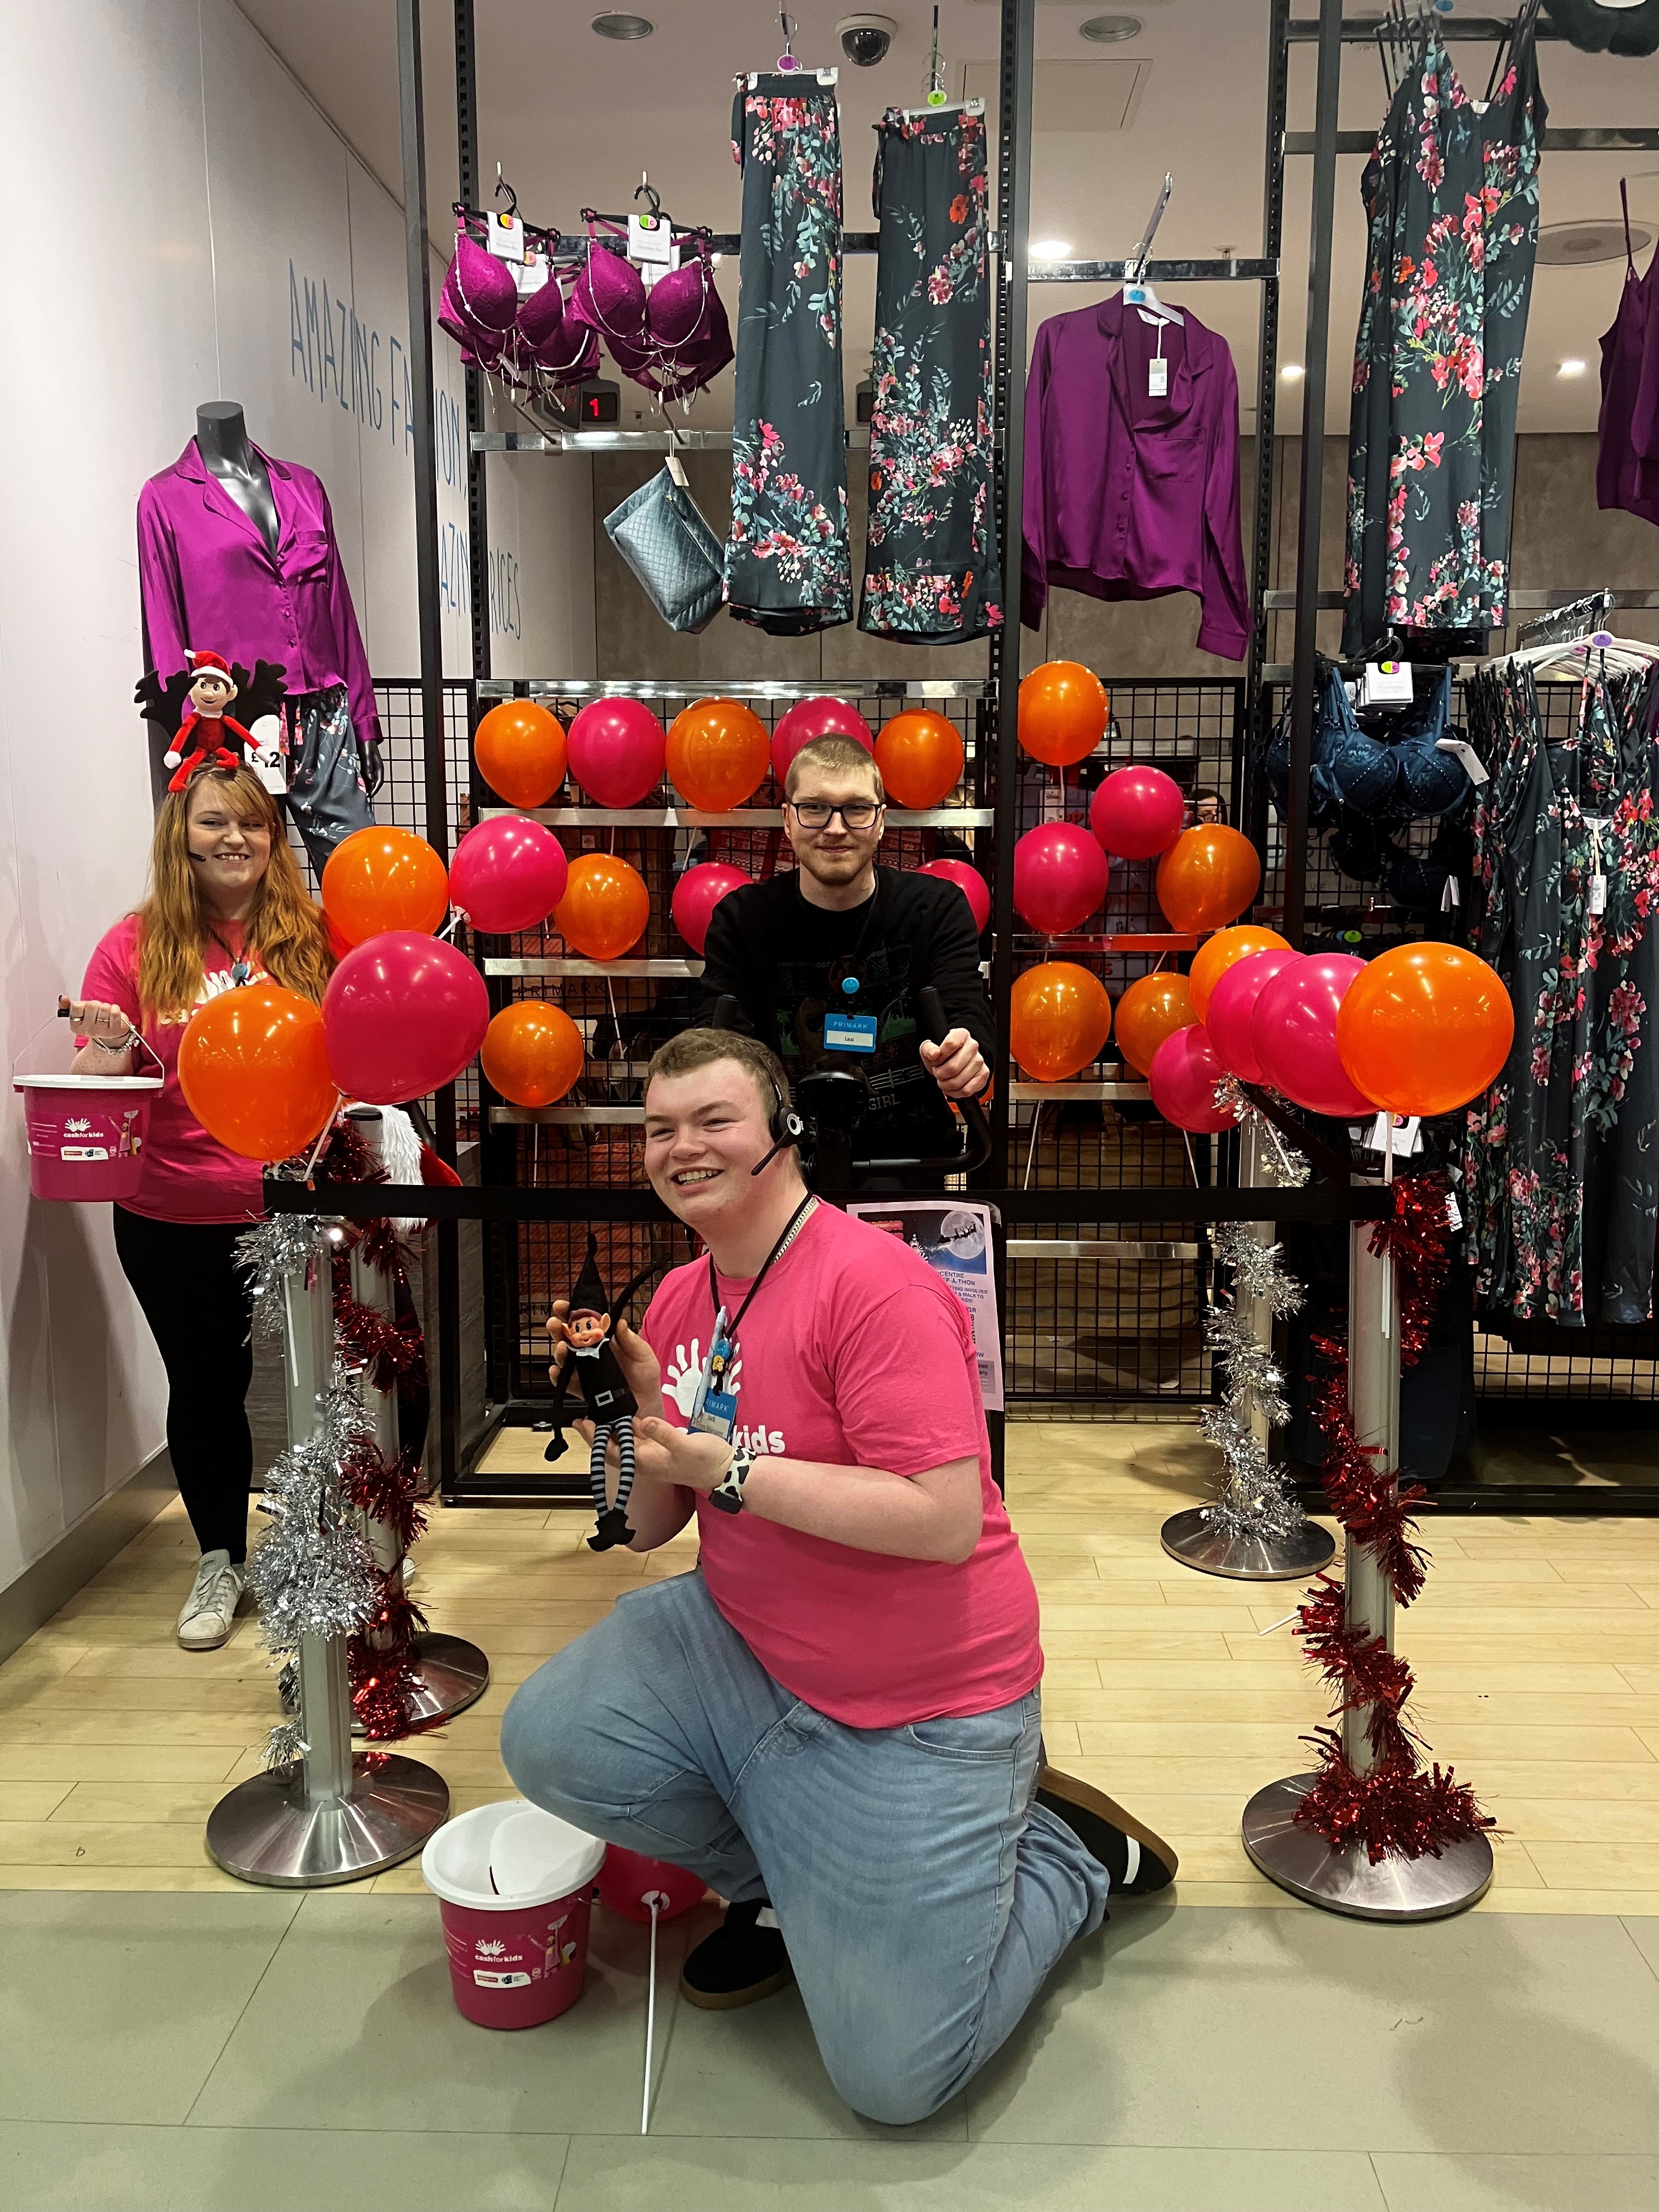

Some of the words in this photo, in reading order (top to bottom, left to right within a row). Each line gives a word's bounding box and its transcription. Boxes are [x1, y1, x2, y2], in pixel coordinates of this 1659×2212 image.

[289, 258, 382, 431] AMAZING
[590, 398, 599, 416] 1
[489, 546, 521, 641] RICES
[833, 1021, 867, 1029] PRIMARK
[868, 1094, 901, 1110] GIRL
[706, 1398, 730, 1413] RIMARK
